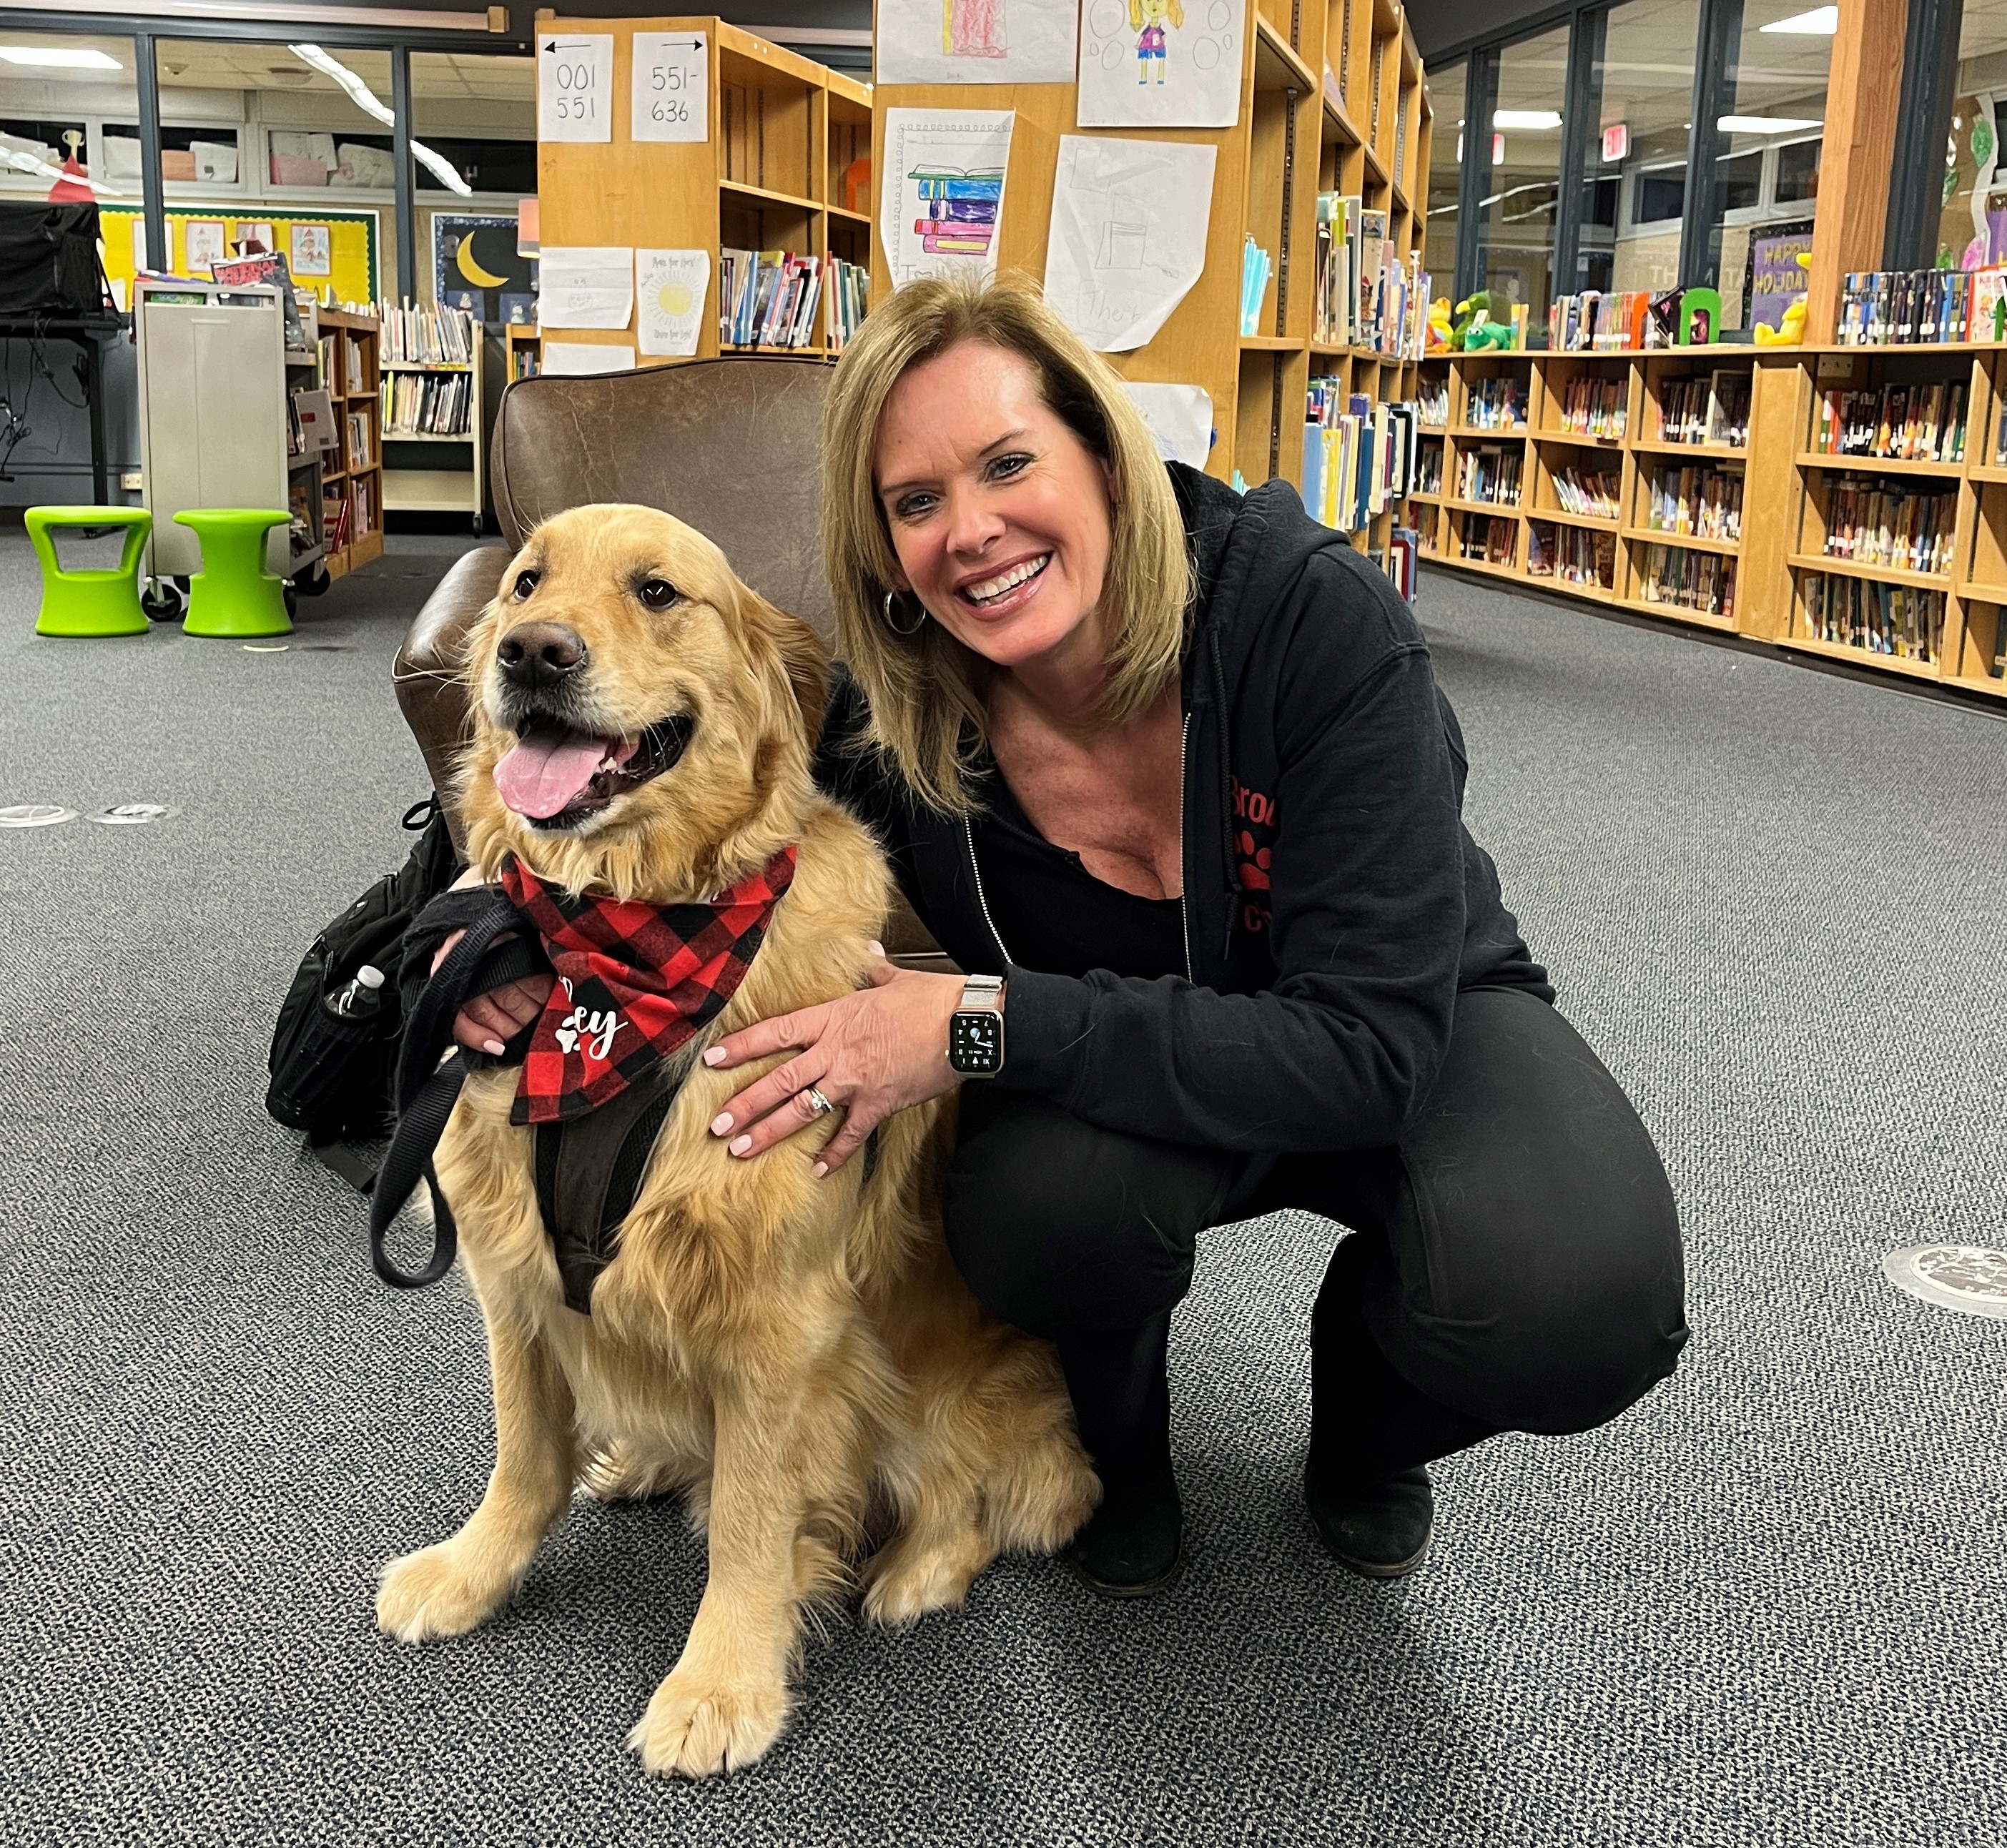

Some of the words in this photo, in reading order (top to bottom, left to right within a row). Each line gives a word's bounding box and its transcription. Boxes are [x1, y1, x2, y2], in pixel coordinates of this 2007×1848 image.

[556, 64, 595, 90] 001
[652, 66, 699, 91] 551-
[557, 97, 595, 119] 551
[651, 100, 689, 122] 636
